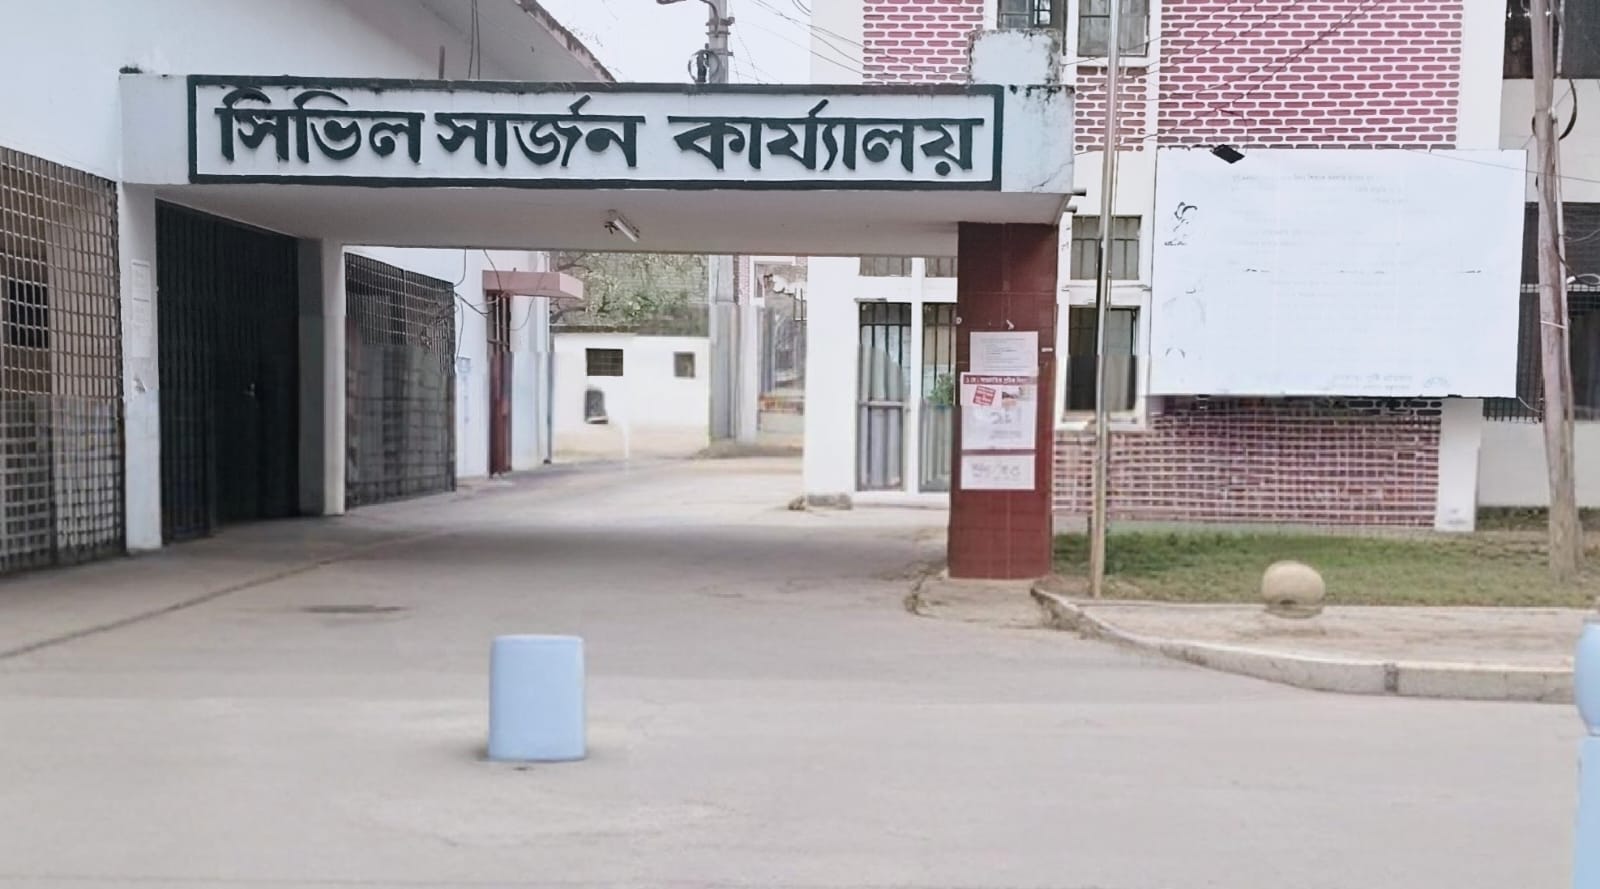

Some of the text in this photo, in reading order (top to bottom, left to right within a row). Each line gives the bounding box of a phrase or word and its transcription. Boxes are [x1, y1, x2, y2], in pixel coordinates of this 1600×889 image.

[214, 87, 985, 176] সিভিল সার্জন কার্য্যালয়
